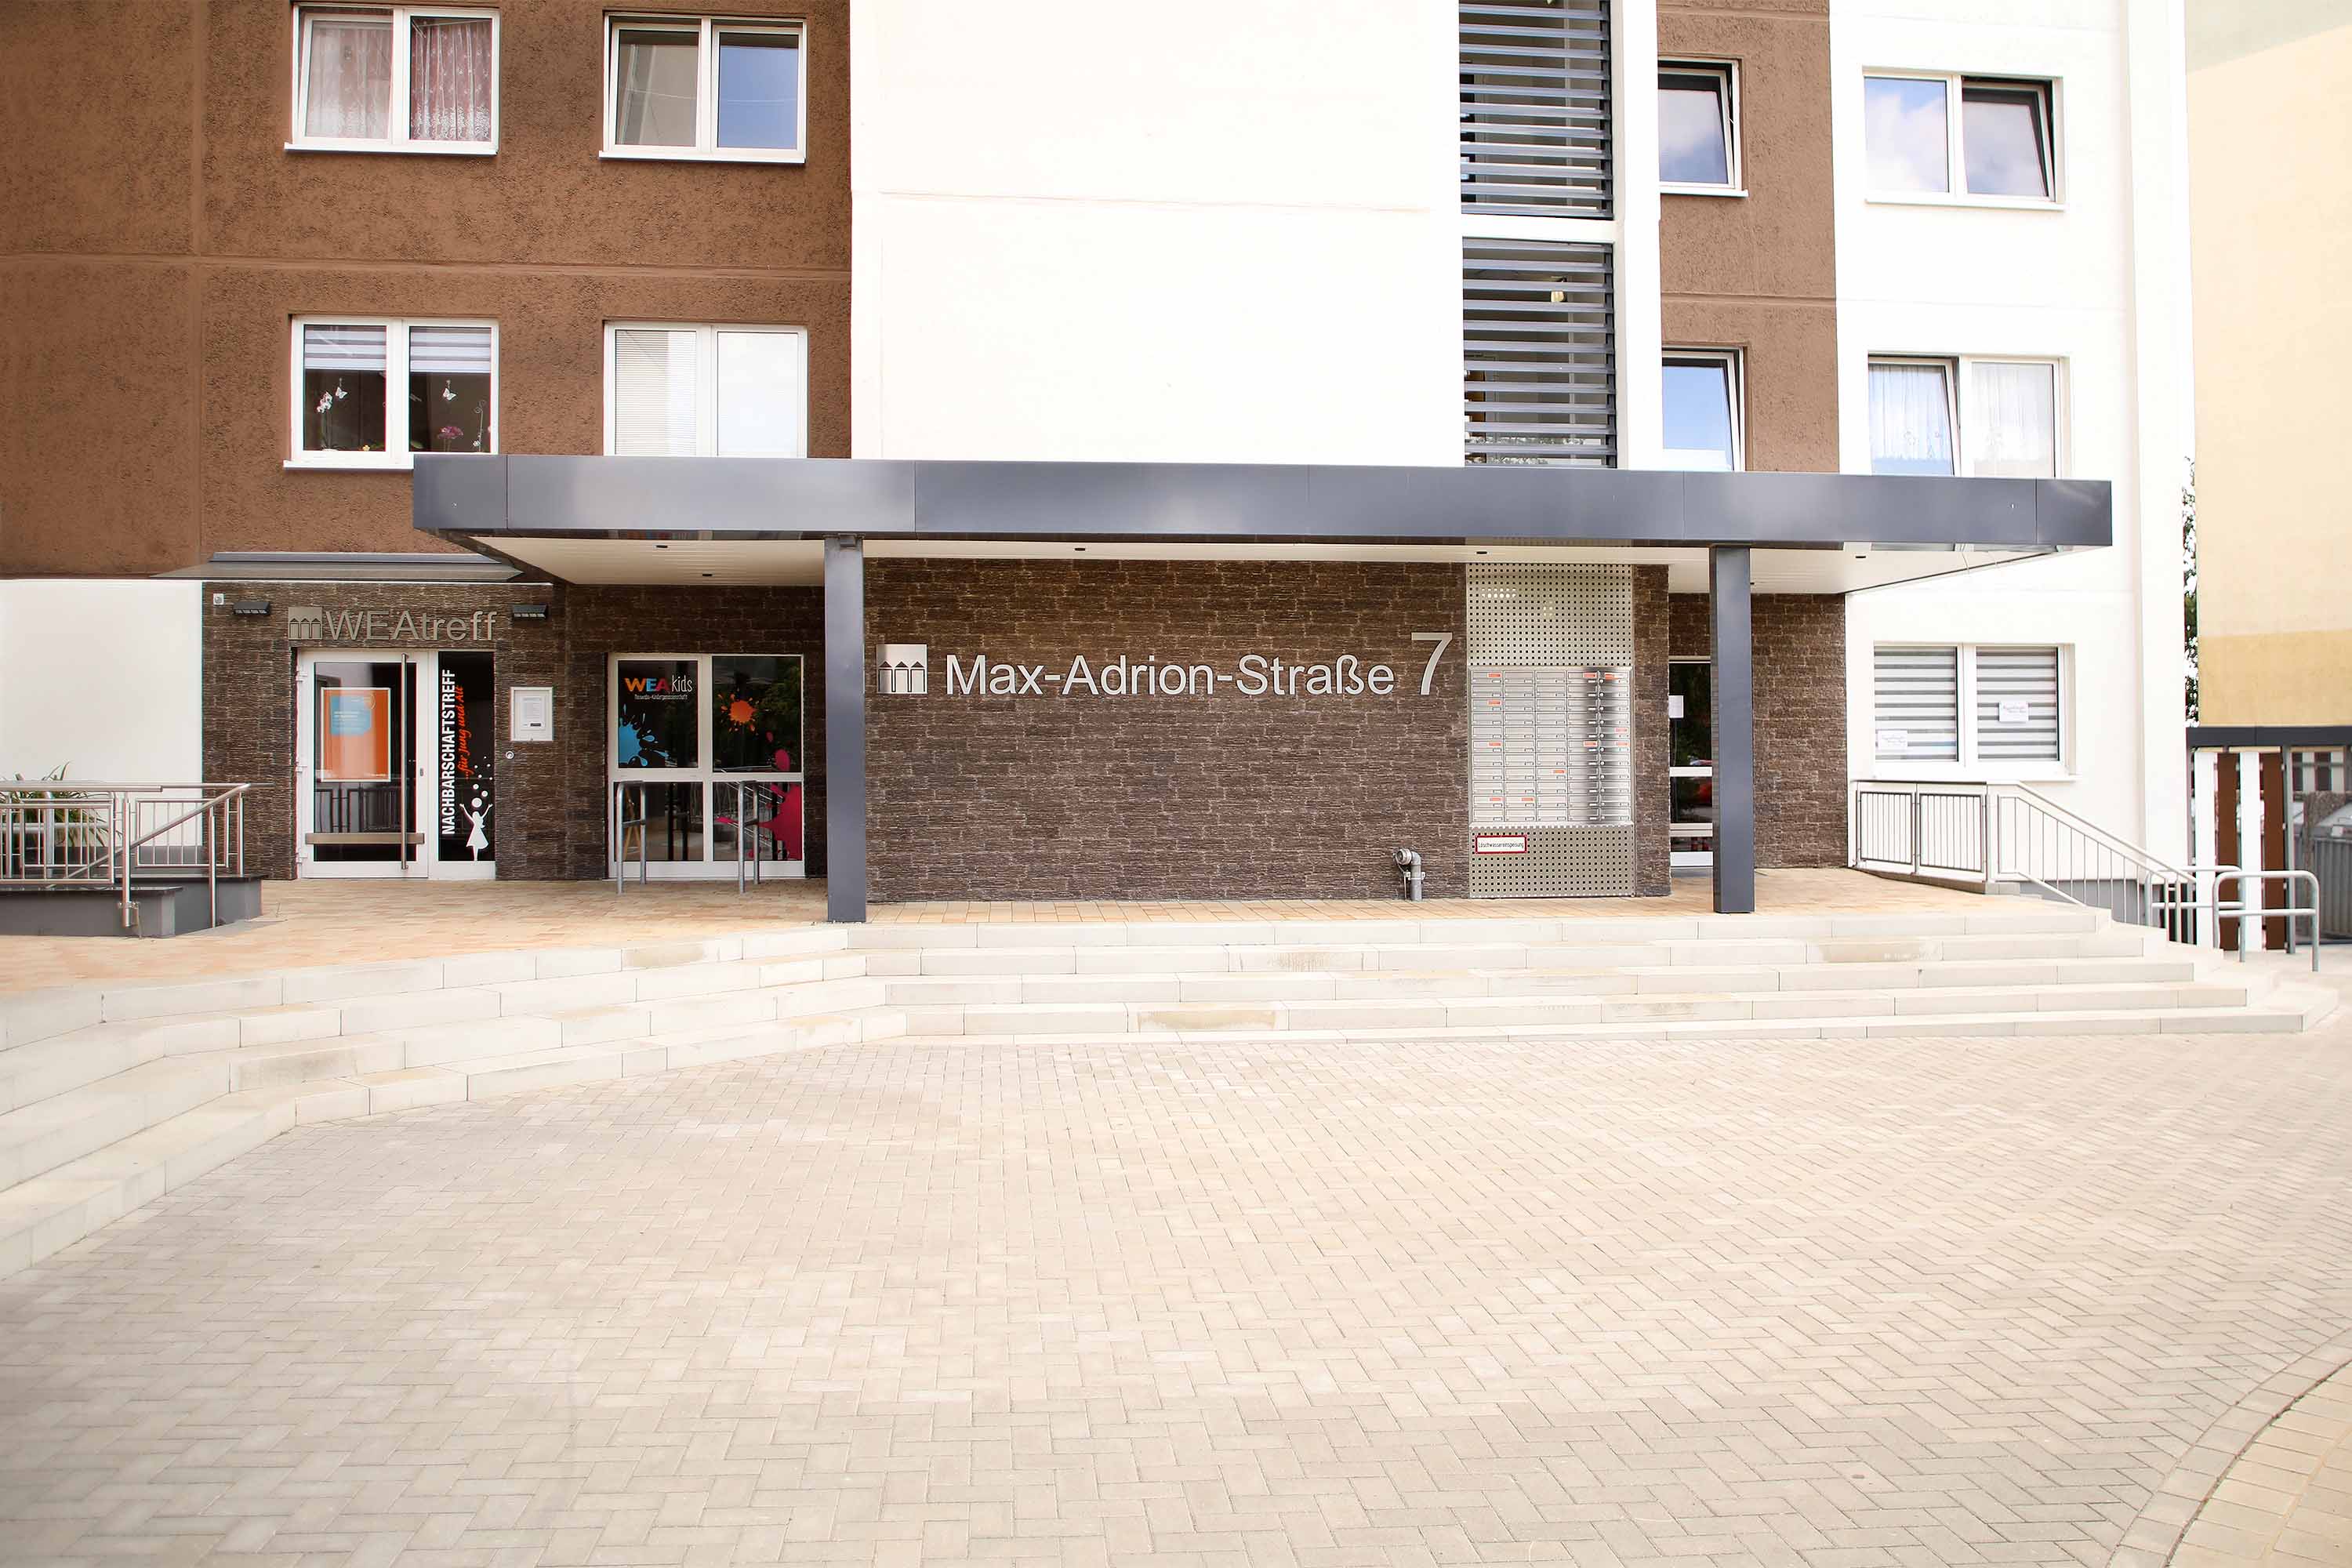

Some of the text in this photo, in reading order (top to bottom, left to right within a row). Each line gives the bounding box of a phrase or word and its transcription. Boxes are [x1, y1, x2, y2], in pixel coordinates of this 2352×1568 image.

[325, 610, 498, 641] WEAtreff
[946, 632, 1454, 696] Max-Adrion-Straße 7
[624, 674, 693, 692] WEA kids
[456, 703, 466, 727] und
[441, 669, 456, 835] NACHBARSCHAFTSTREFF
